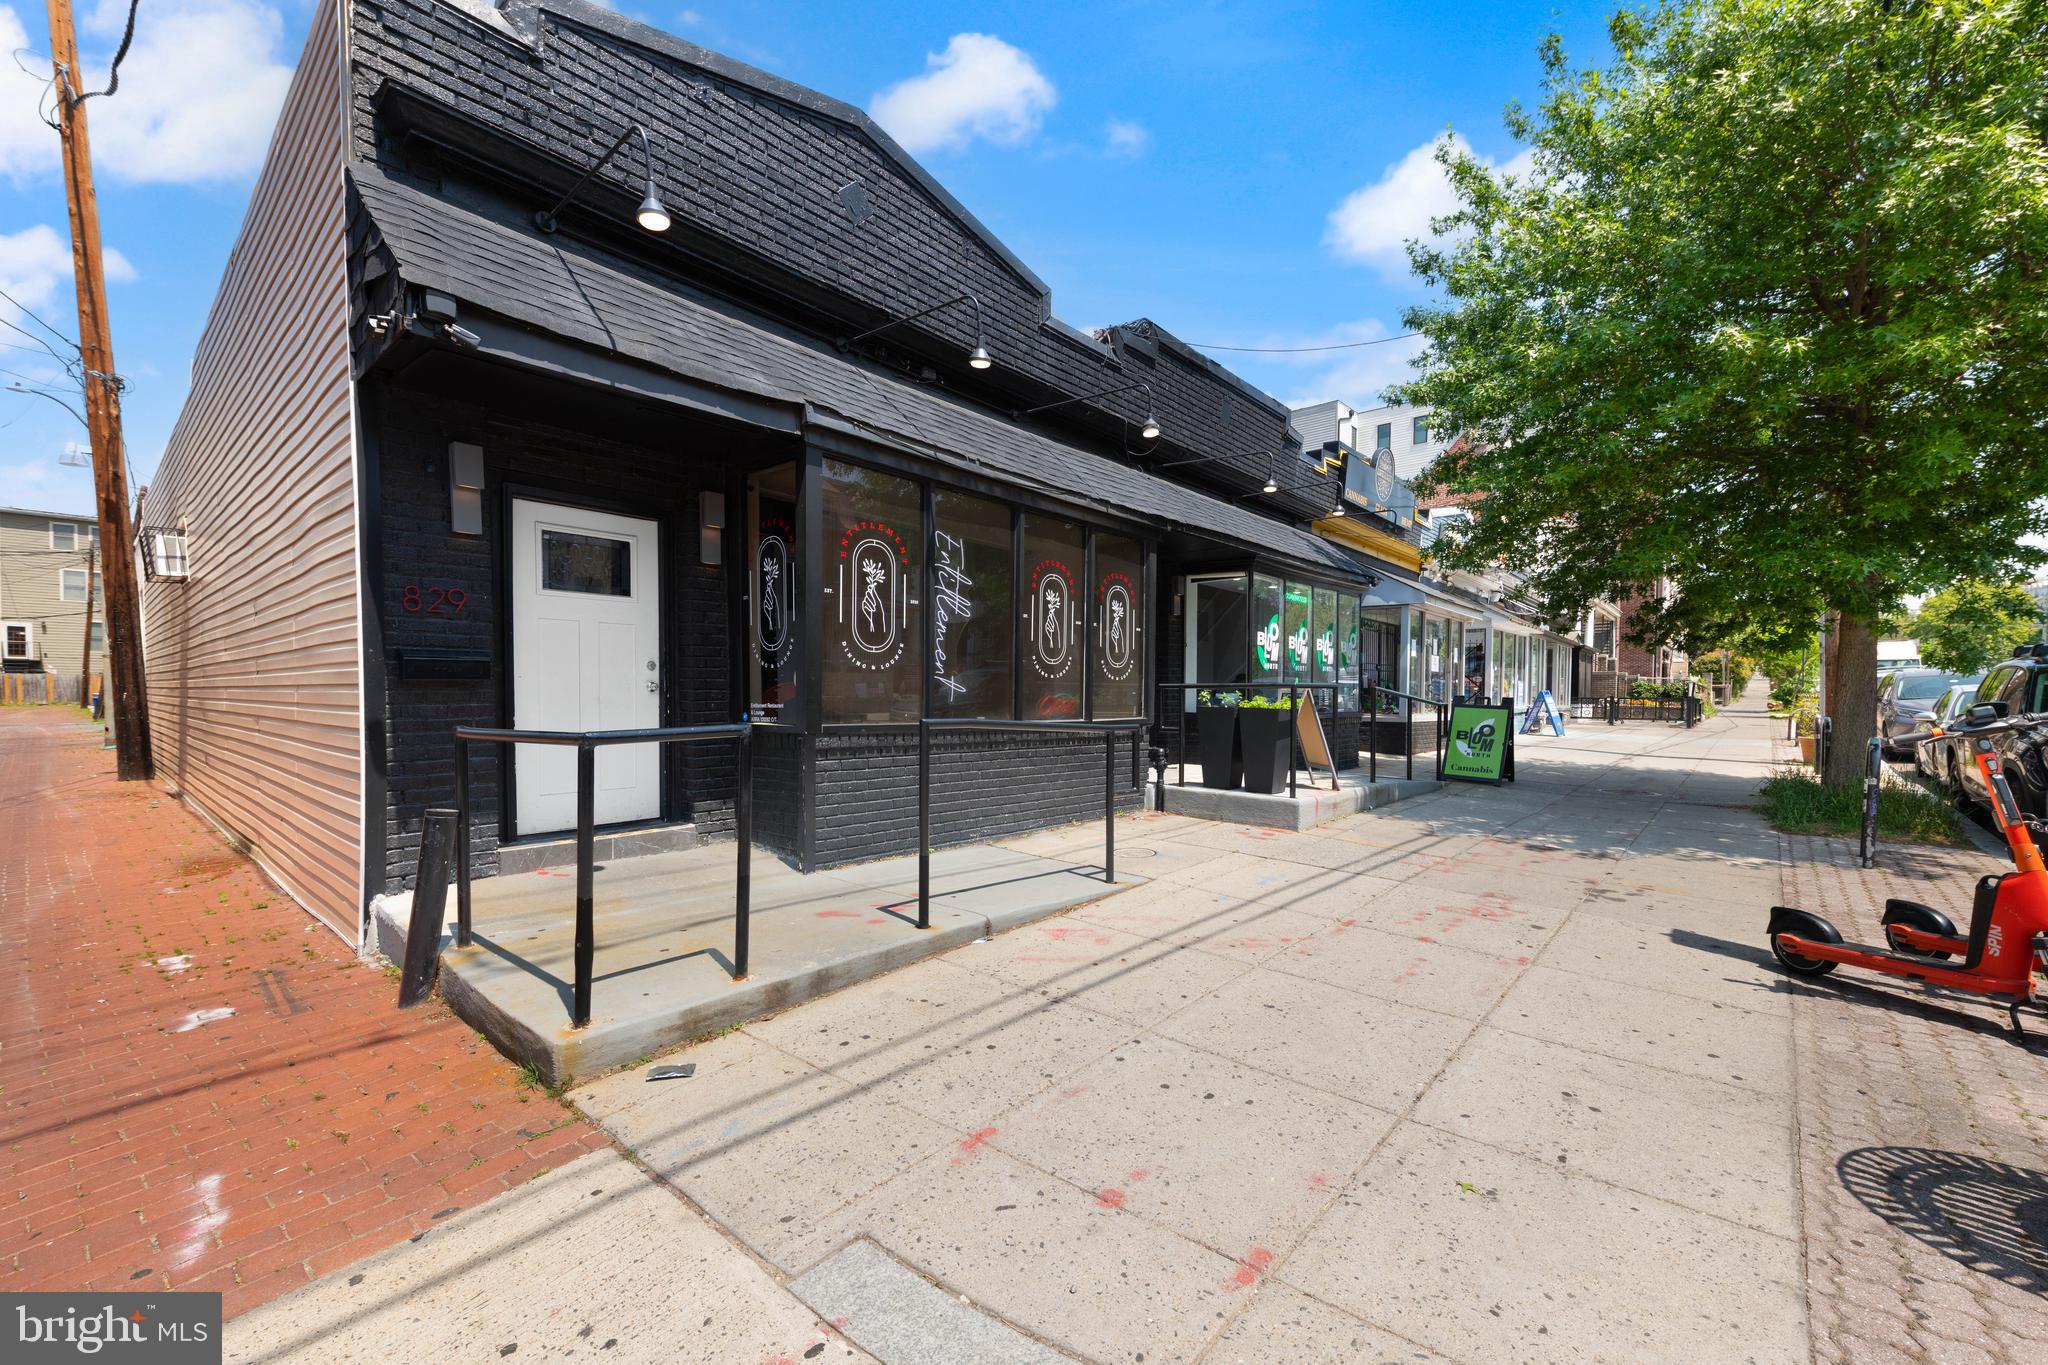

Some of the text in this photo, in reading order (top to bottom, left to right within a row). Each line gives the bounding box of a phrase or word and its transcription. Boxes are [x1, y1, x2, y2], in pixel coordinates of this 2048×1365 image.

[839, 521, 909, 566] ENTITLEMENT
[402, 584, 468, 614] 829
[934, 530, 973, 703] Entitlement
[841, 640, 867, 669] DINING
[880, 642, 905, 670] LOUNGE
[1257, 622, 1280, 662] BLOOM
[1288, 627, 1308, 664] BLOOM
[1456, 724, 1496, 753] BLOOM
[1450, 762, 1494, 774] Cannabis
[1987, 923, 2002, 957] SPIN
